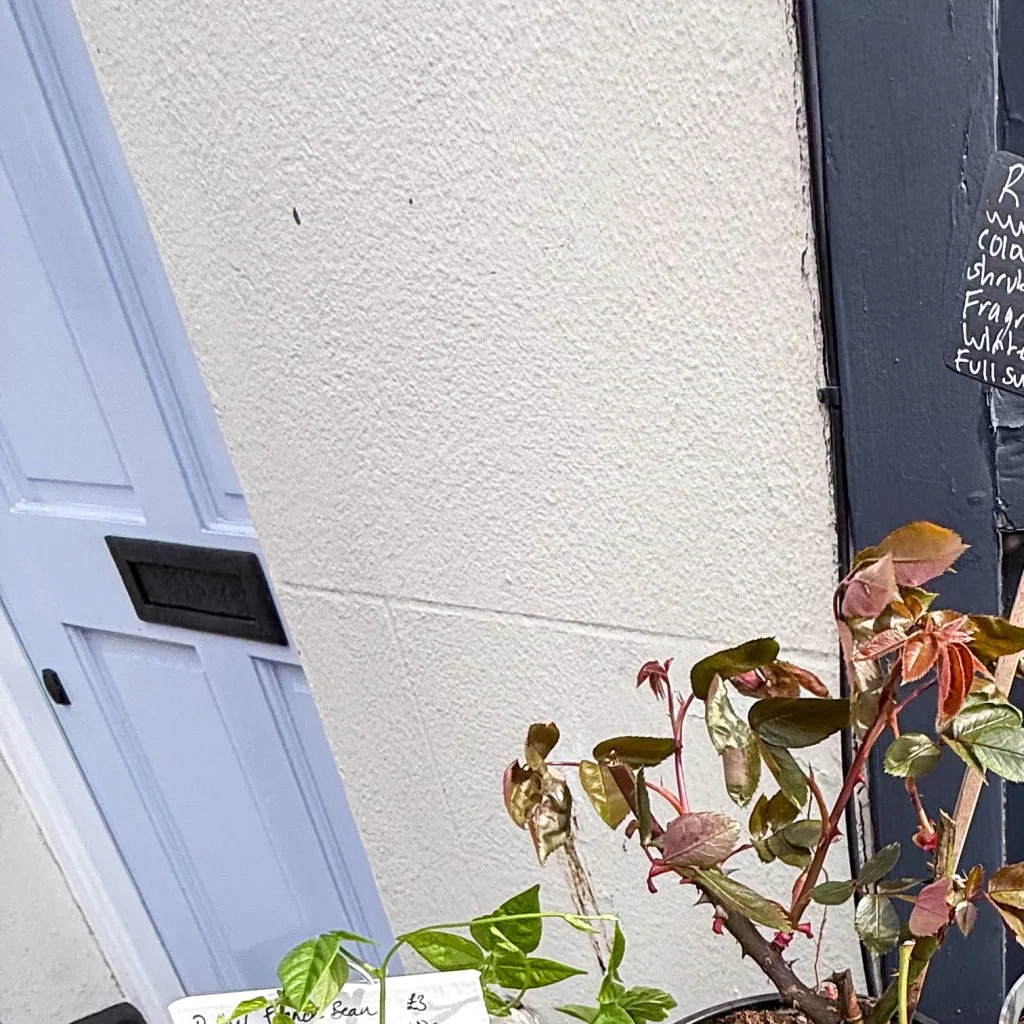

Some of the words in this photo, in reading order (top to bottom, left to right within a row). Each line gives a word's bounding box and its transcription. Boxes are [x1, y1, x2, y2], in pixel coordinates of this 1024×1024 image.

[955, 348, 996, 383] Full
[330, 1000, 378, 1020] Bean
[406, 992, 427, 1012] £3
